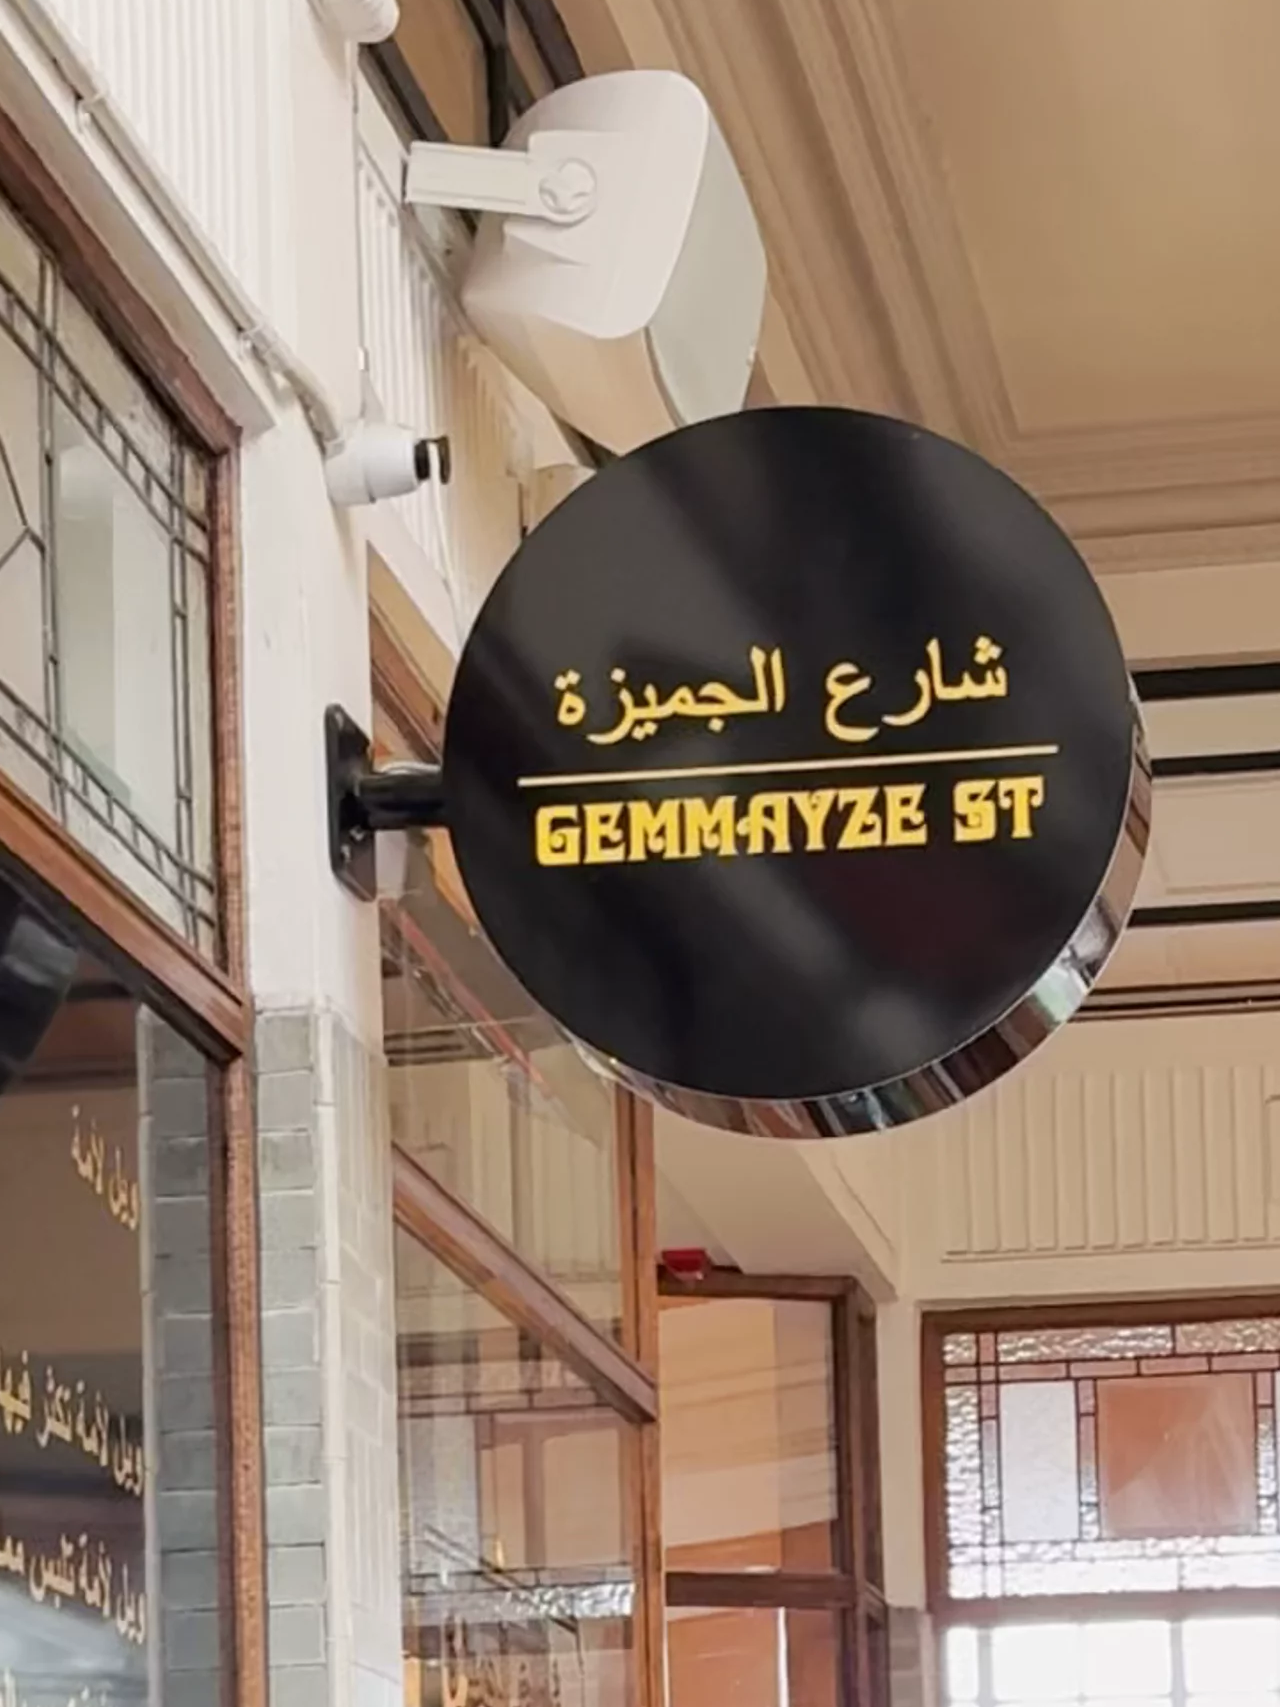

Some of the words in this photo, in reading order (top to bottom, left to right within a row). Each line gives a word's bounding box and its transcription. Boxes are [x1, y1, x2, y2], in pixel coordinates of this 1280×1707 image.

[553, 645, 787, 746] الجميزة
[826, 635, 1010, 741] شارع
[535, 783, 929, 867] GEMMAYZE
[953, 775, 1046, 842] ST
